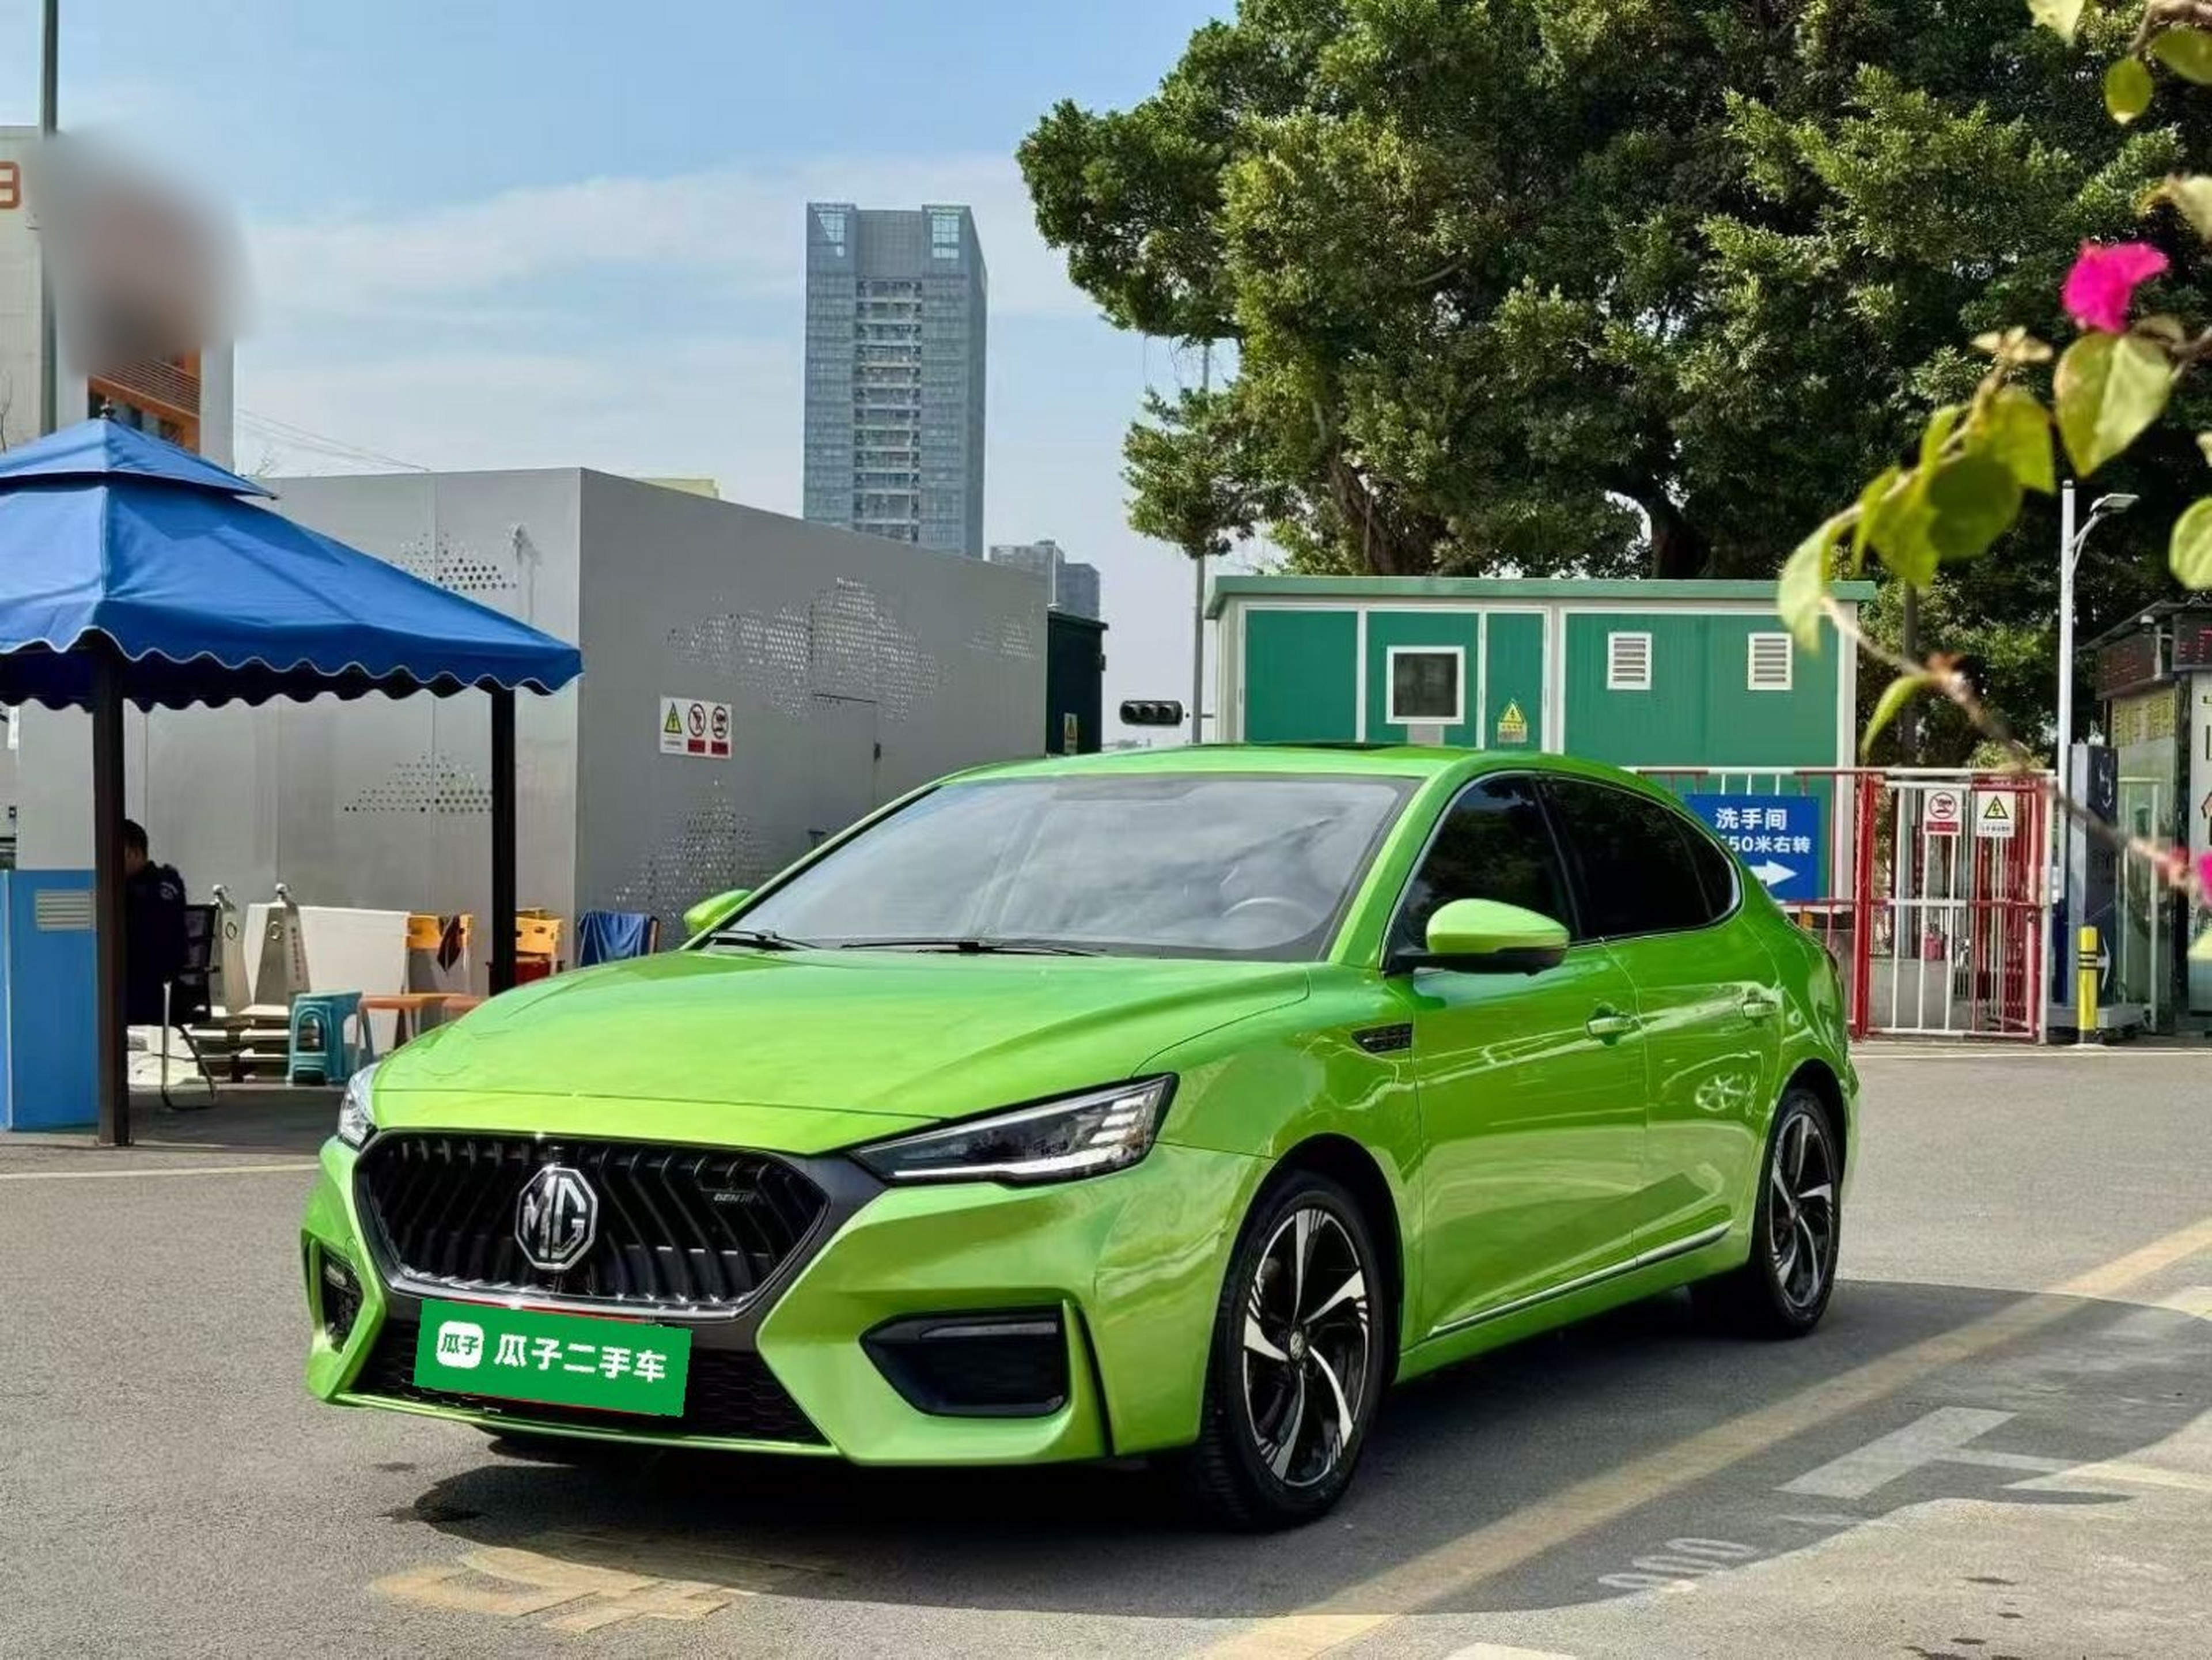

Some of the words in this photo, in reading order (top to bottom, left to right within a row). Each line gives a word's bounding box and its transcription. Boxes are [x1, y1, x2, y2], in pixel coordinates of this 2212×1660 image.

[1715, 807, 1787, 830] 洗手间
[1720, 835, 1811, 853] 50米右转
[522, 1175, 586, 1260] MG
